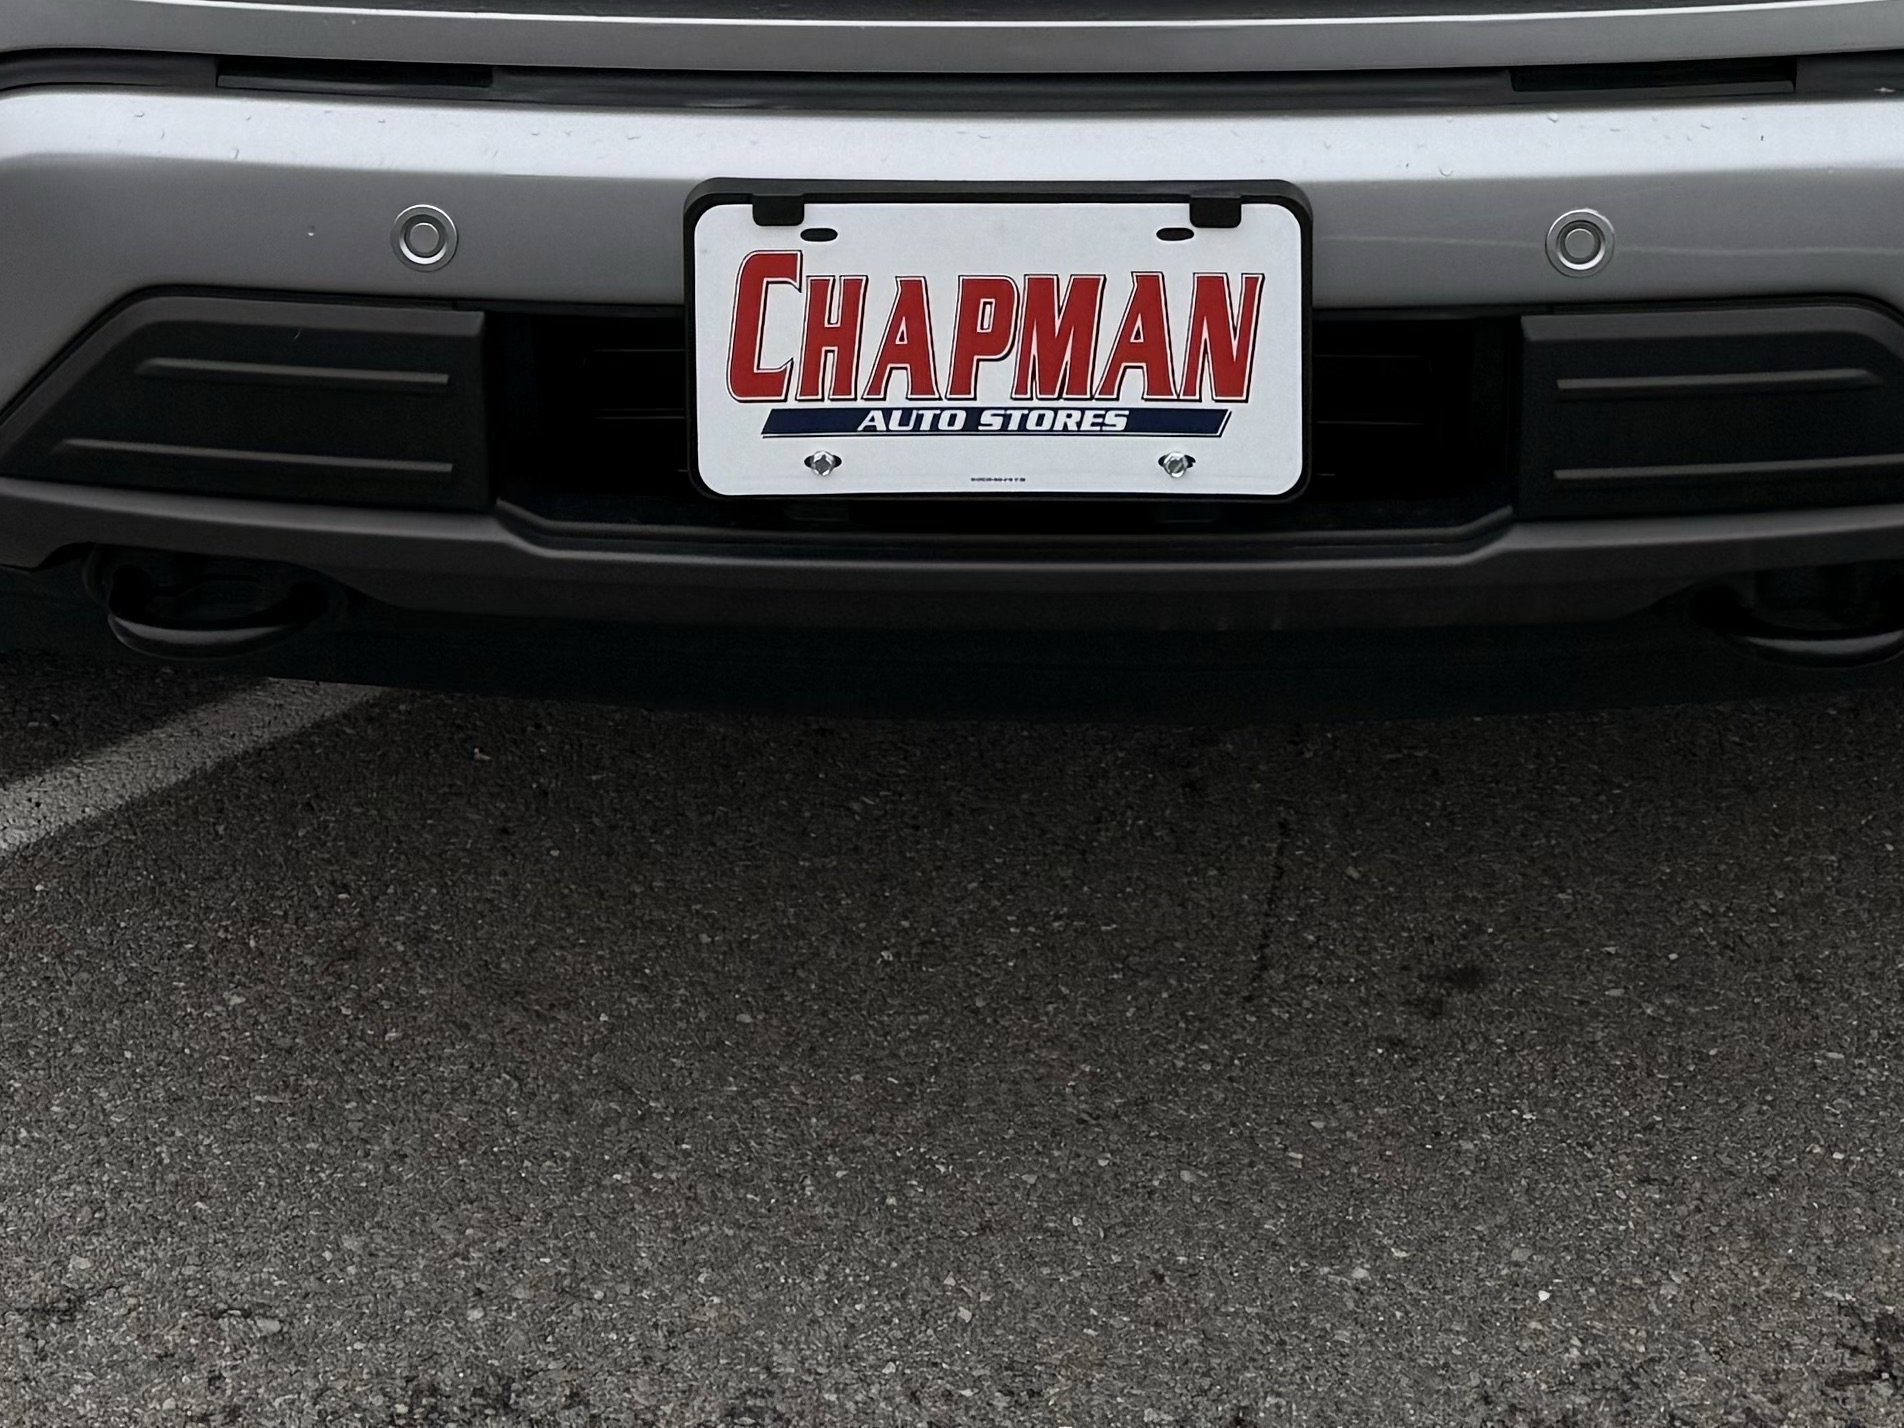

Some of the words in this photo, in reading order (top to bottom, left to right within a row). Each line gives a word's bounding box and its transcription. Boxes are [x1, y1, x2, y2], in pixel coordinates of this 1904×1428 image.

[726, 249, 1265, 402] CHAPMAN
[856, 409, 967, 432] AUTO
[978, 409, 1130, 432] STORES
